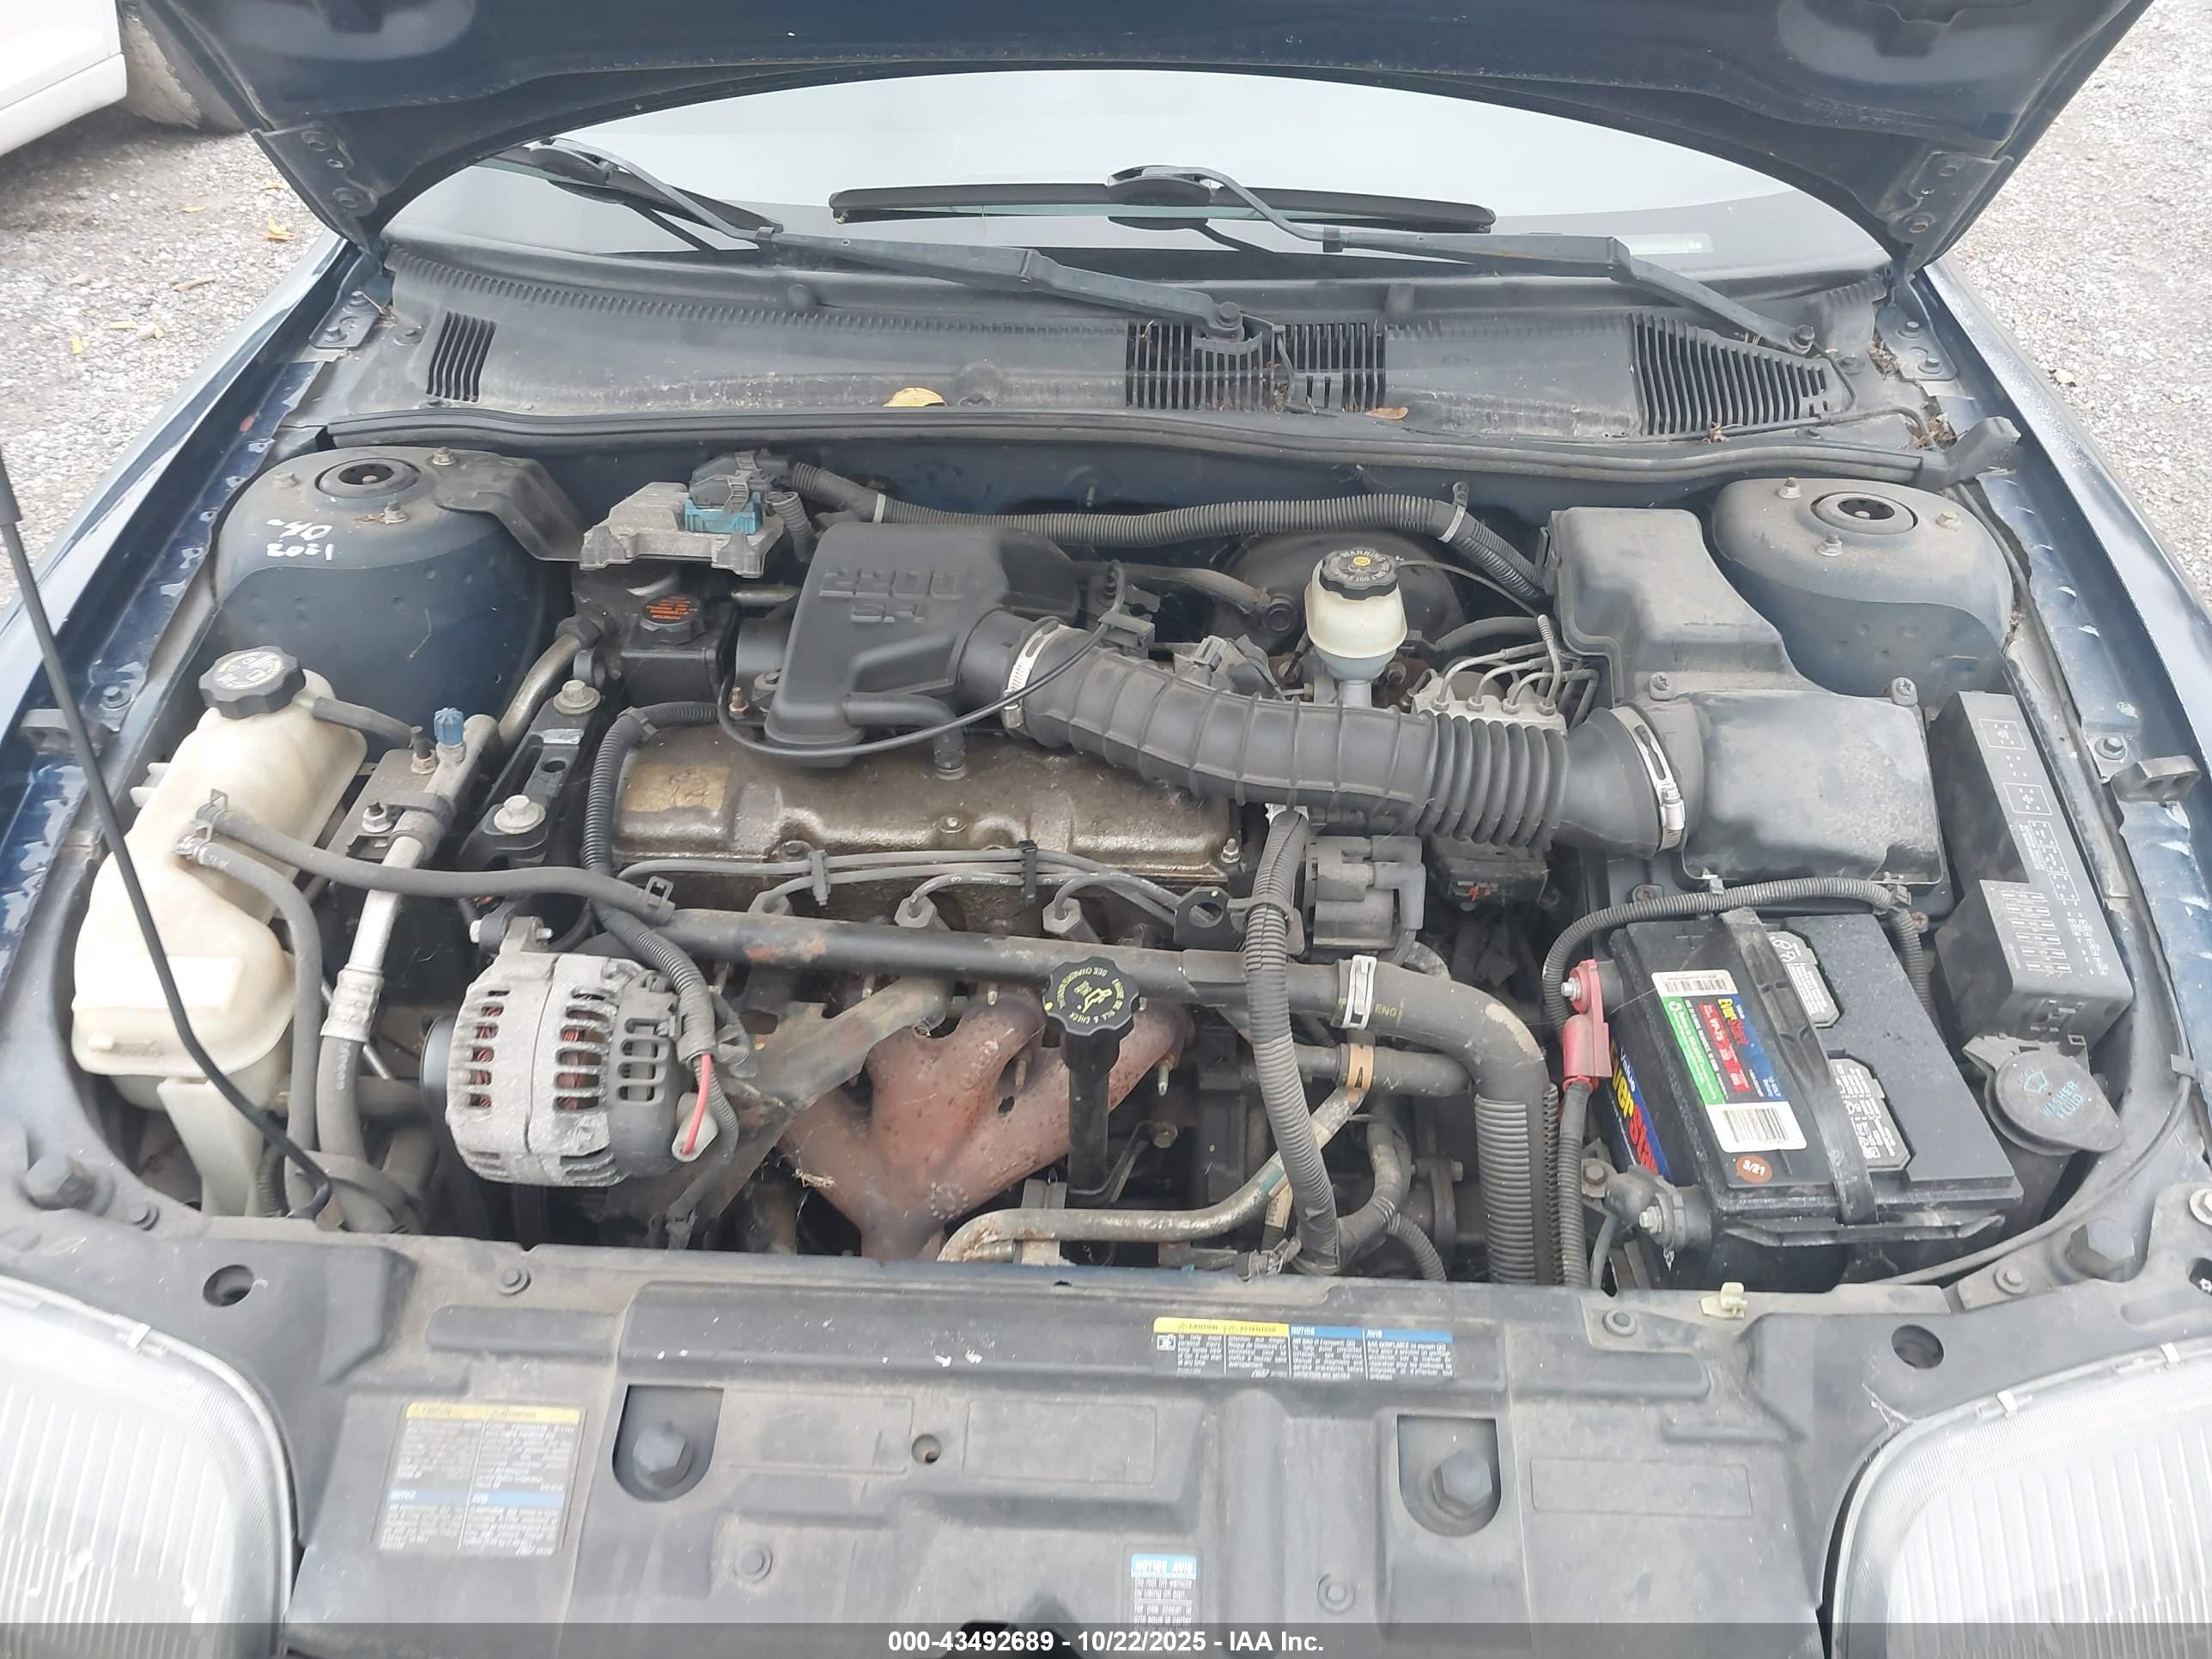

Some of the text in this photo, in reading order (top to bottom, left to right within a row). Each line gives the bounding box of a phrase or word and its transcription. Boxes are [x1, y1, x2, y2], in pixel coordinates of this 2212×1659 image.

[1620, 1048, 1636, 1093] Value
[2039, 1080, 2079, 1120] WASHER
[1742, 1159, 1765, 1176] 3/21
[1291, 1326, 1315, 1335] NOTICE
[1367, 1328, 1382, 1338] AVIS
